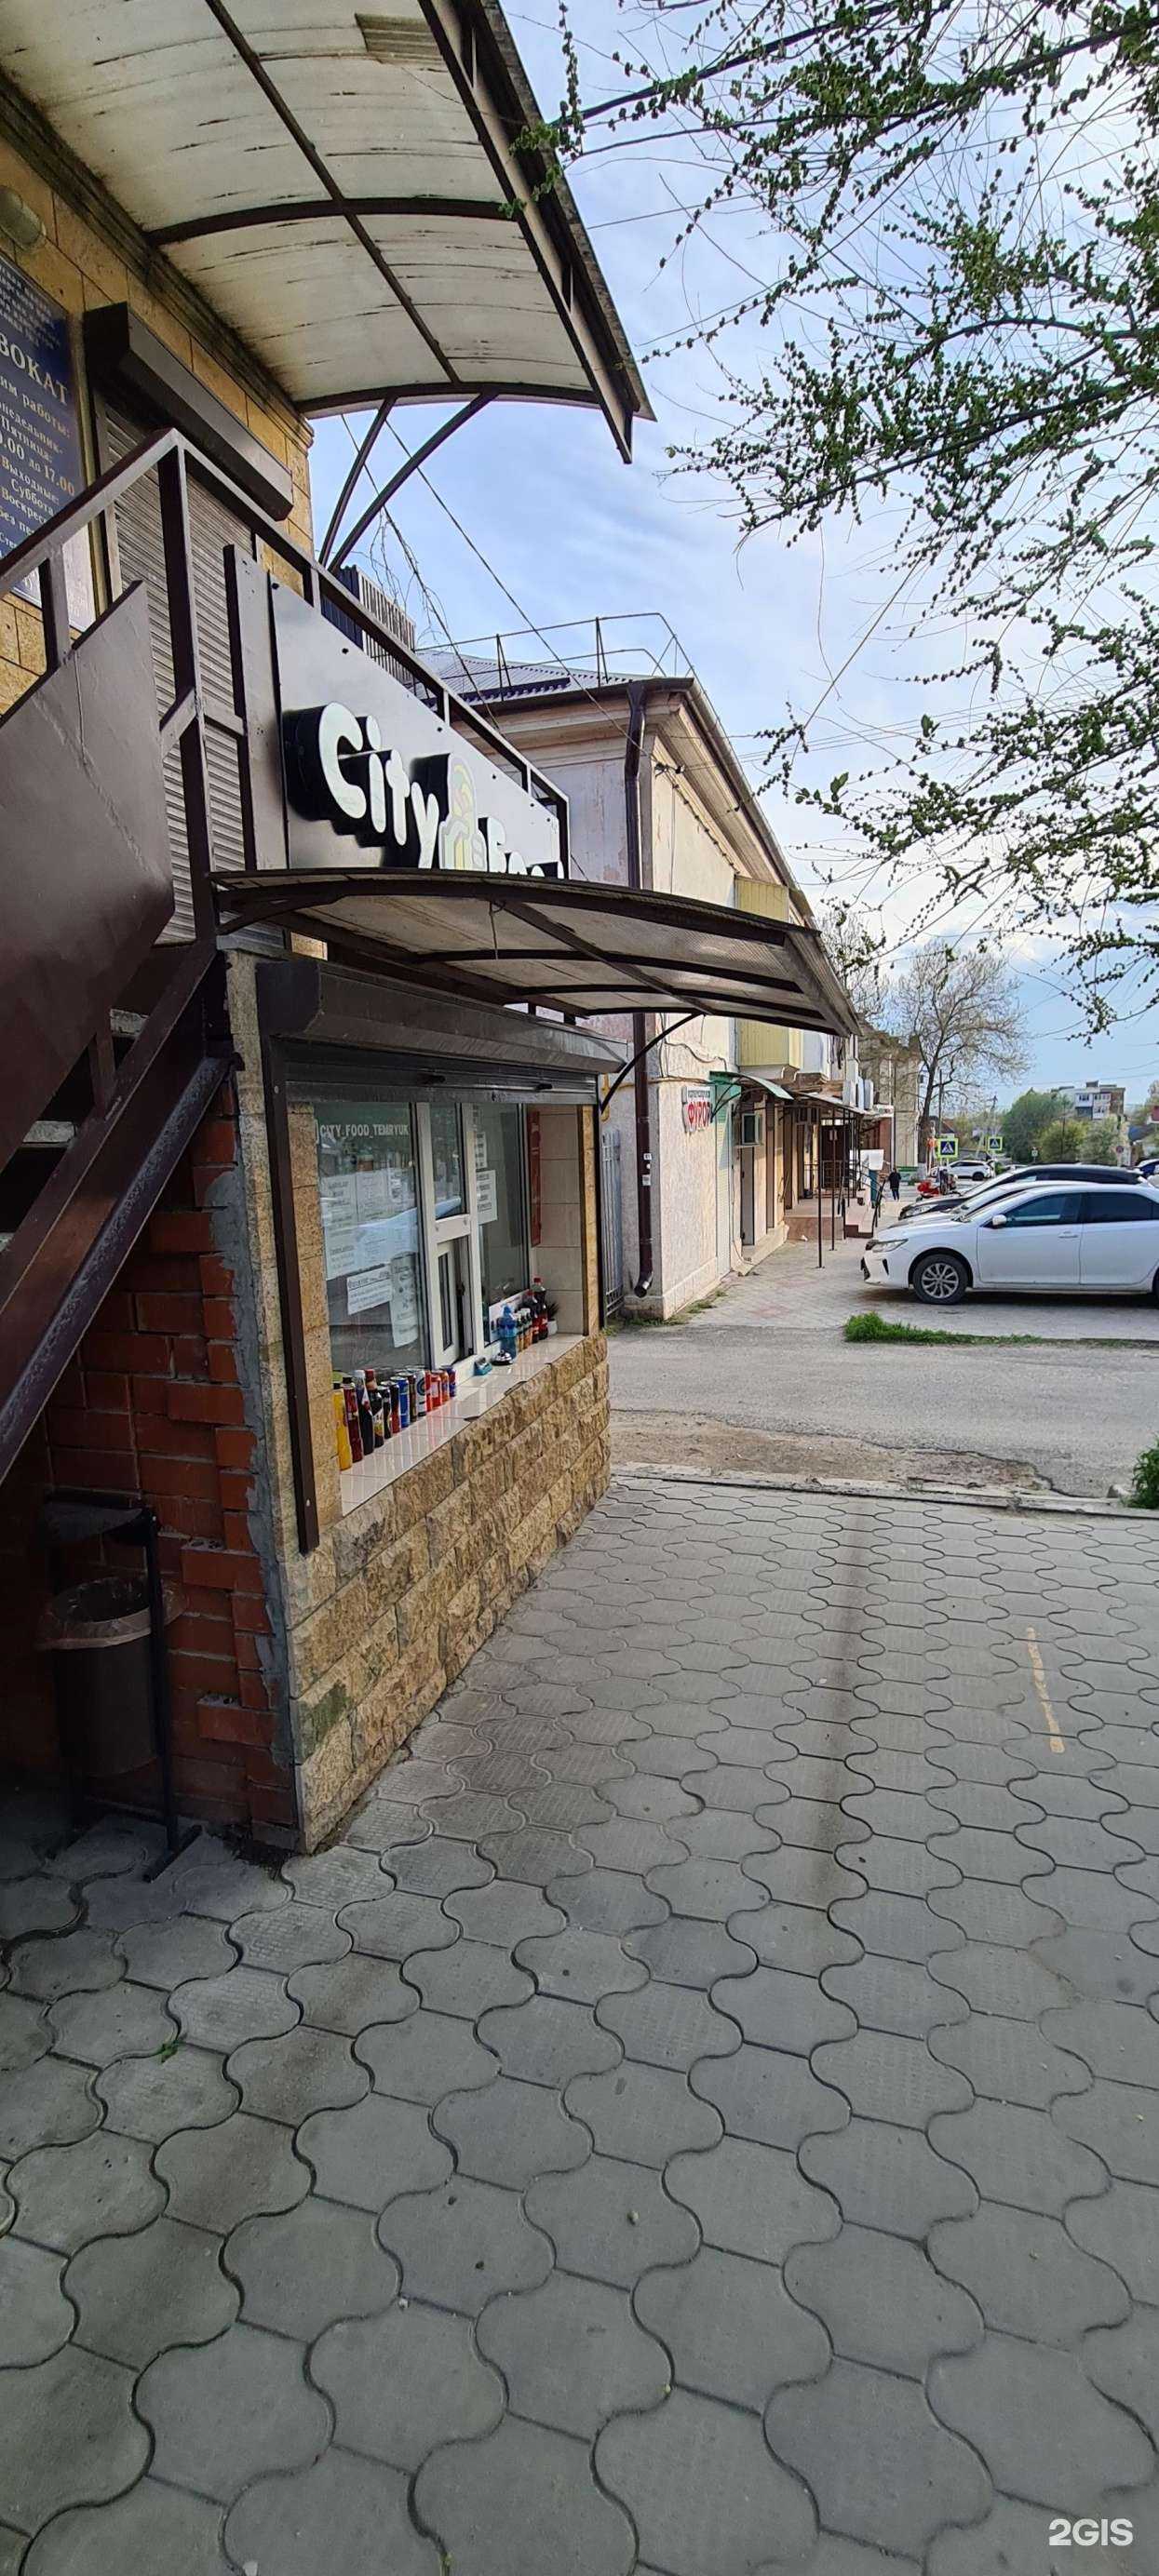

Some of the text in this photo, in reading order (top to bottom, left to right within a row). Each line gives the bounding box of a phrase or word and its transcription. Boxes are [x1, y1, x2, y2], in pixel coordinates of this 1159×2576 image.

[29, 458, 41, 474] до
[45, 464, 75, 497] 17.00
[2, 487, 47, 525] Воскрес
[318, 701, 439, 869] City
